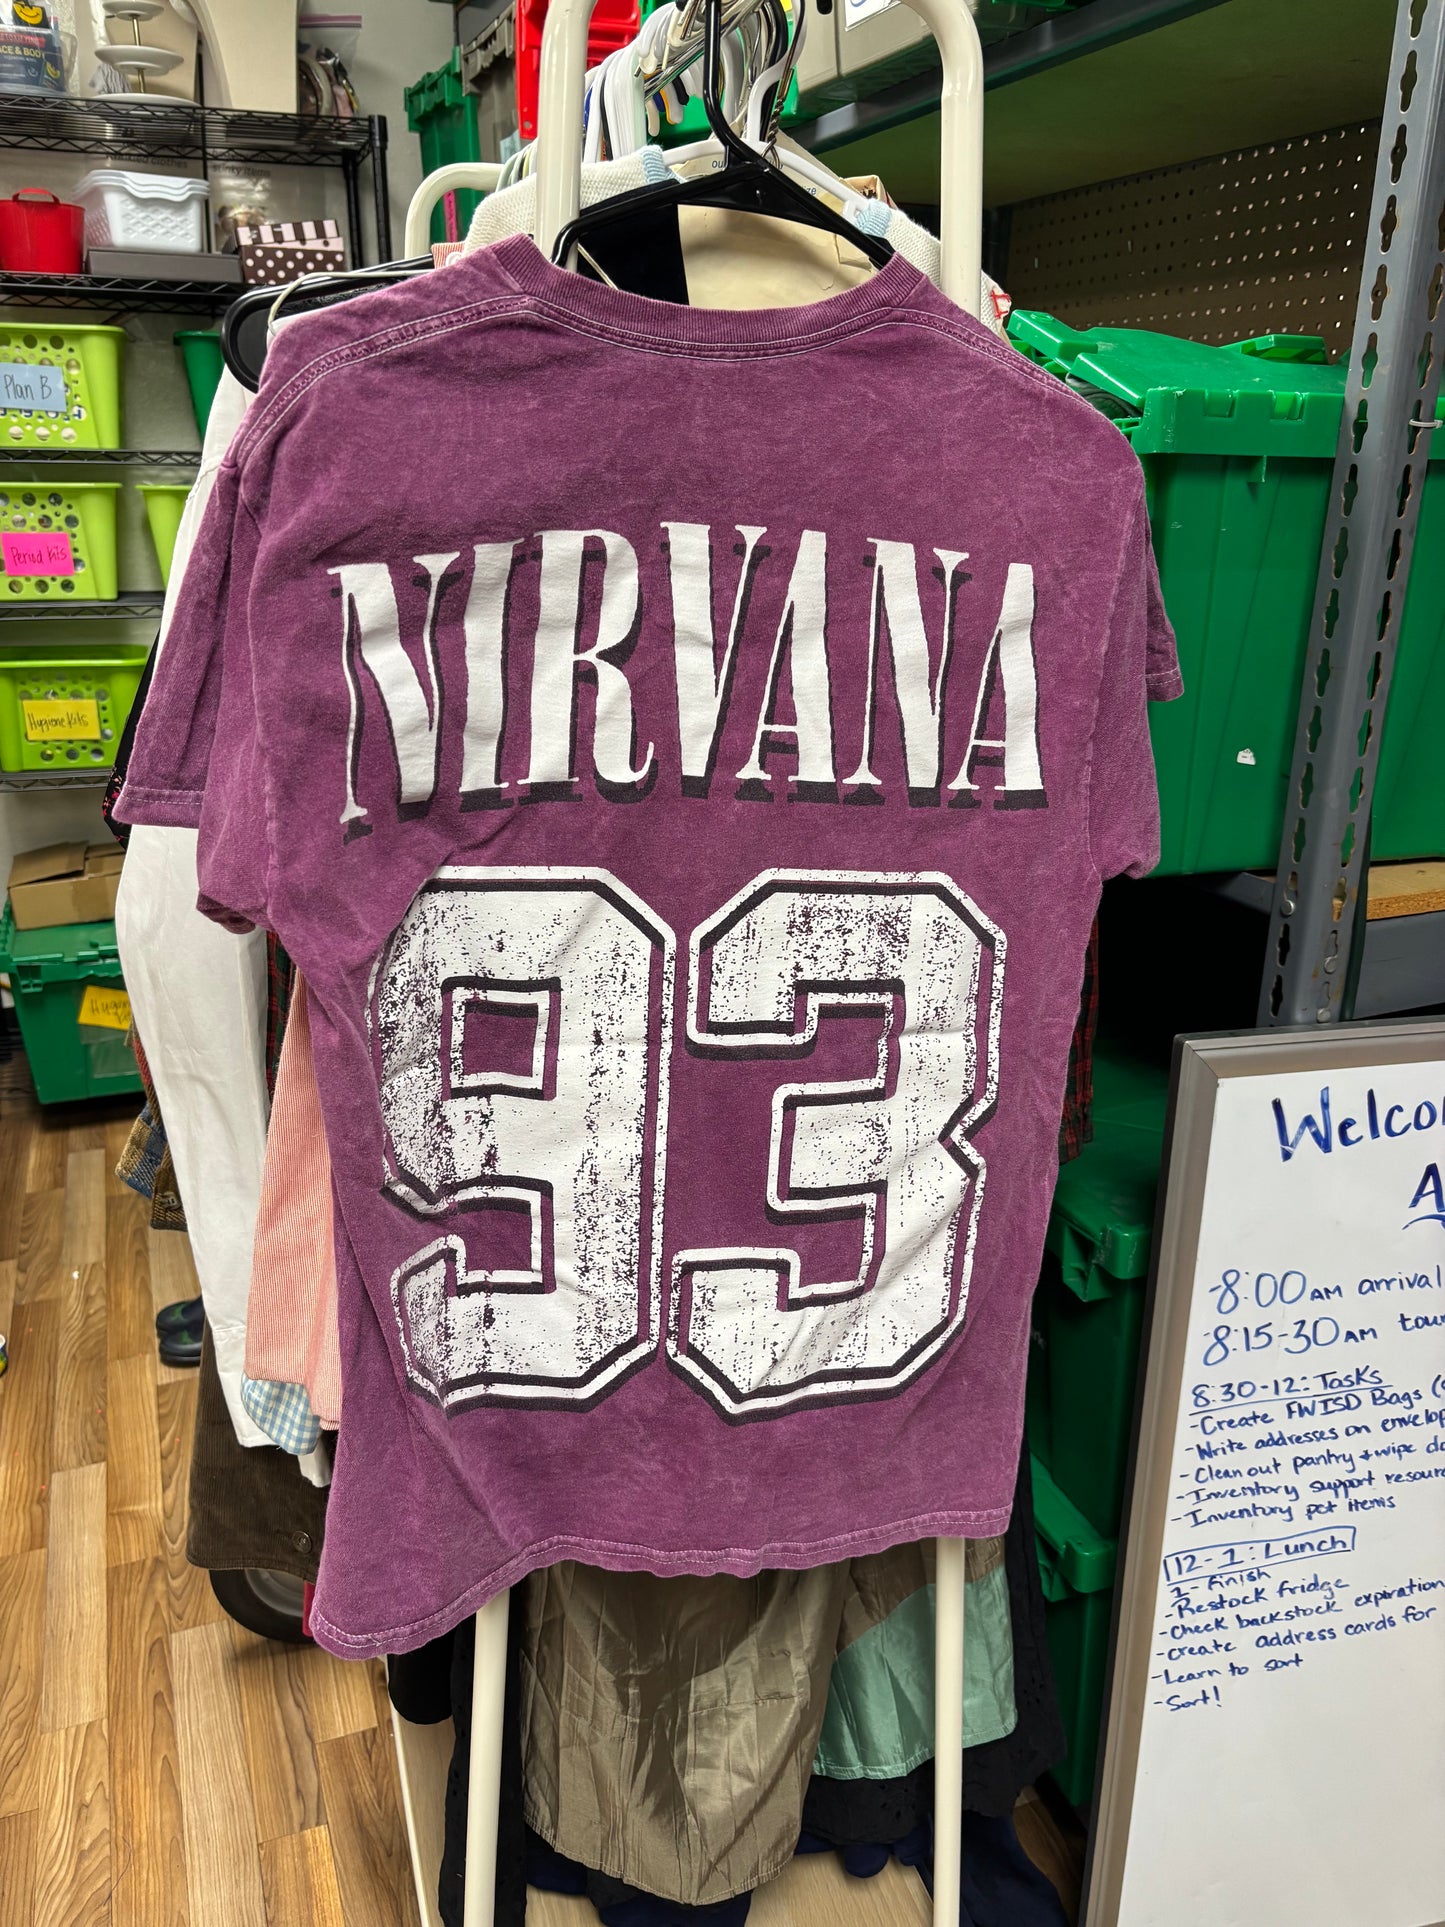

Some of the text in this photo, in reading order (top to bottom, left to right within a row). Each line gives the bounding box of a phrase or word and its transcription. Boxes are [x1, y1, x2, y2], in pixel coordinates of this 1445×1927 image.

[4, 374, 52, 400] Plan B
[10, 546, 44, 566] Period
[327, 521, 1048, 842] NIRVANA
[1271, 1085, 1445, 1162] Welco
[365, 865, 1008, 1426] 93
[1310, 1285, 1343, 1301] AM
[1358, 1265, 1441, 1295] arrival
[1344, 1327, 1378, 1343] AM
[1286, 1393, 1362, 1419] FWISD
[1370, 1388, 1423, 1410] Bags
[1254, 1427, 1339, 1450] addresses
[1345, 1424, 1371, 1437] on
[1247, 1457, 1281, 1477] out
[1292, 1448, 1356, 1475] pantry
[1309, 1470, 1376, 1499] support
[1348, 1495, 1396, 1512] items
[1264, 1535, 1347, 1559] Lunch
[1277, 1573, 1350, 1600] fridge
[1236, 1600, 1343, 1629] backstock
[1255, 1628, 1337, 1648] address
[1344, 1613, 1397, 1636] cards
[1402, 1605, 1437, 1624] for
[1228, 1662, 1249, 1677] to
[1264, 1653, 1304, 1672] sort
